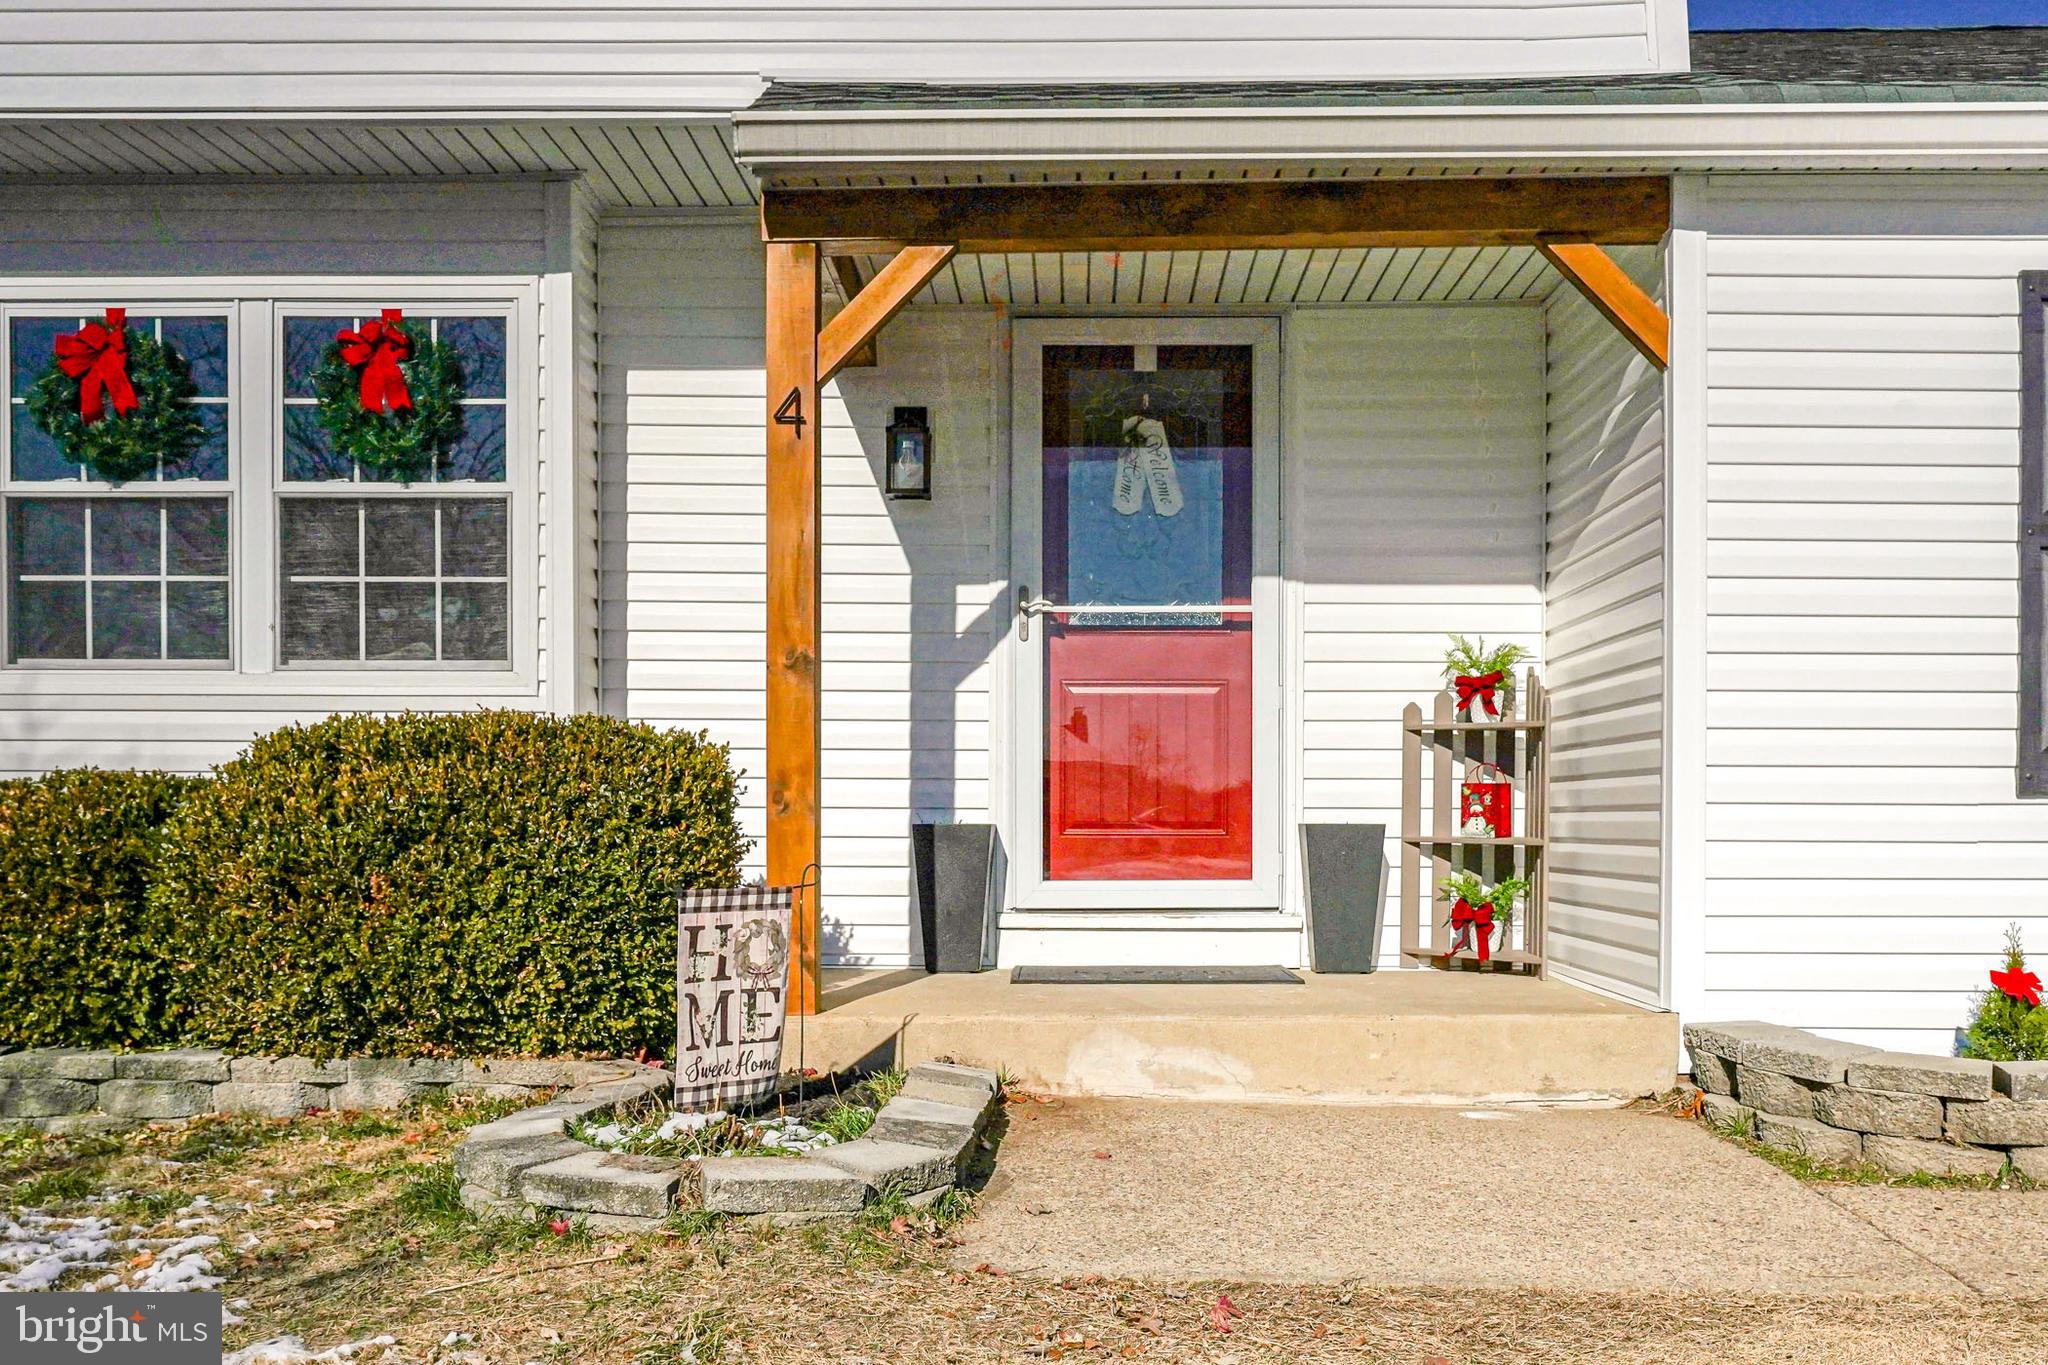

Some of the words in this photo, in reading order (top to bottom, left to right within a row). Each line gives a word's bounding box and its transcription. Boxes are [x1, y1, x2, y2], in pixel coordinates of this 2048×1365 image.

[773, 386, 807, 440] 4
[1145, 433, 1173, 505] Welcome
[685, 1056, 732, 1083] Sweet
